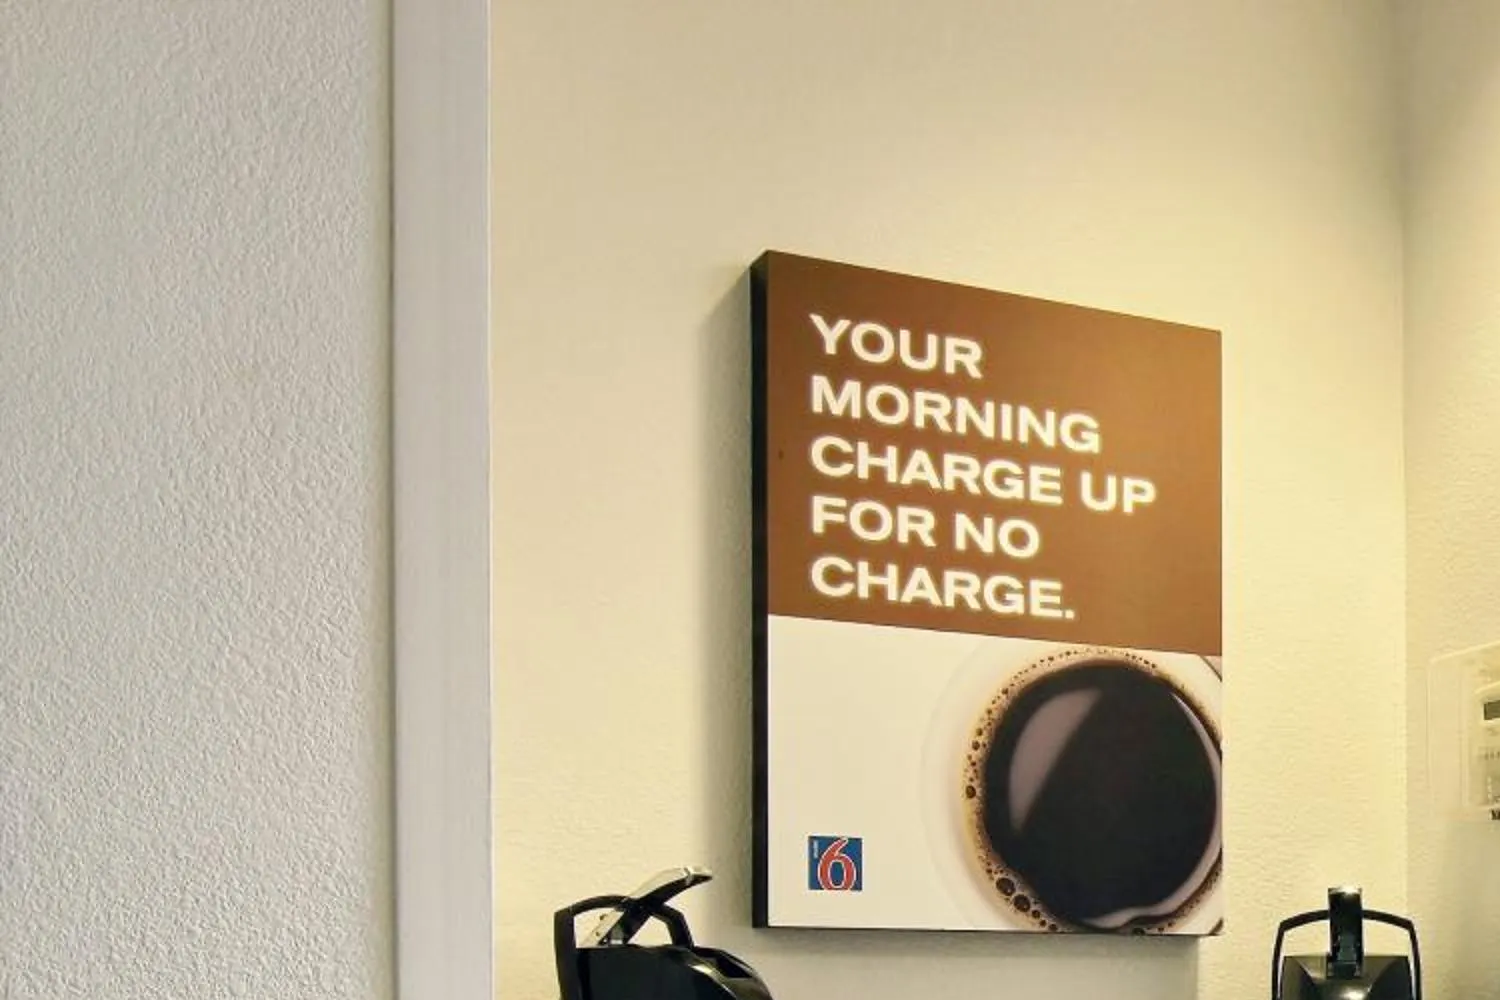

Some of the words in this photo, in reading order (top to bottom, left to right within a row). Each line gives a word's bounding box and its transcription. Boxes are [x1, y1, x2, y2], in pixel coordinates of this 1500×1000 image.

[809, 313, 984, 379] YOUR
[811, 374, 1101, 454] MORNING
[810, 435, 1064, 505] CHARGE
[1079, 470, 1156, 514] UP
[811, 494, 936, 547] FOR
[954, 511, 1040, 559] NO
[810, 555, 1075, 620] CHARGE.
[817, 836, 857, 891] 6
